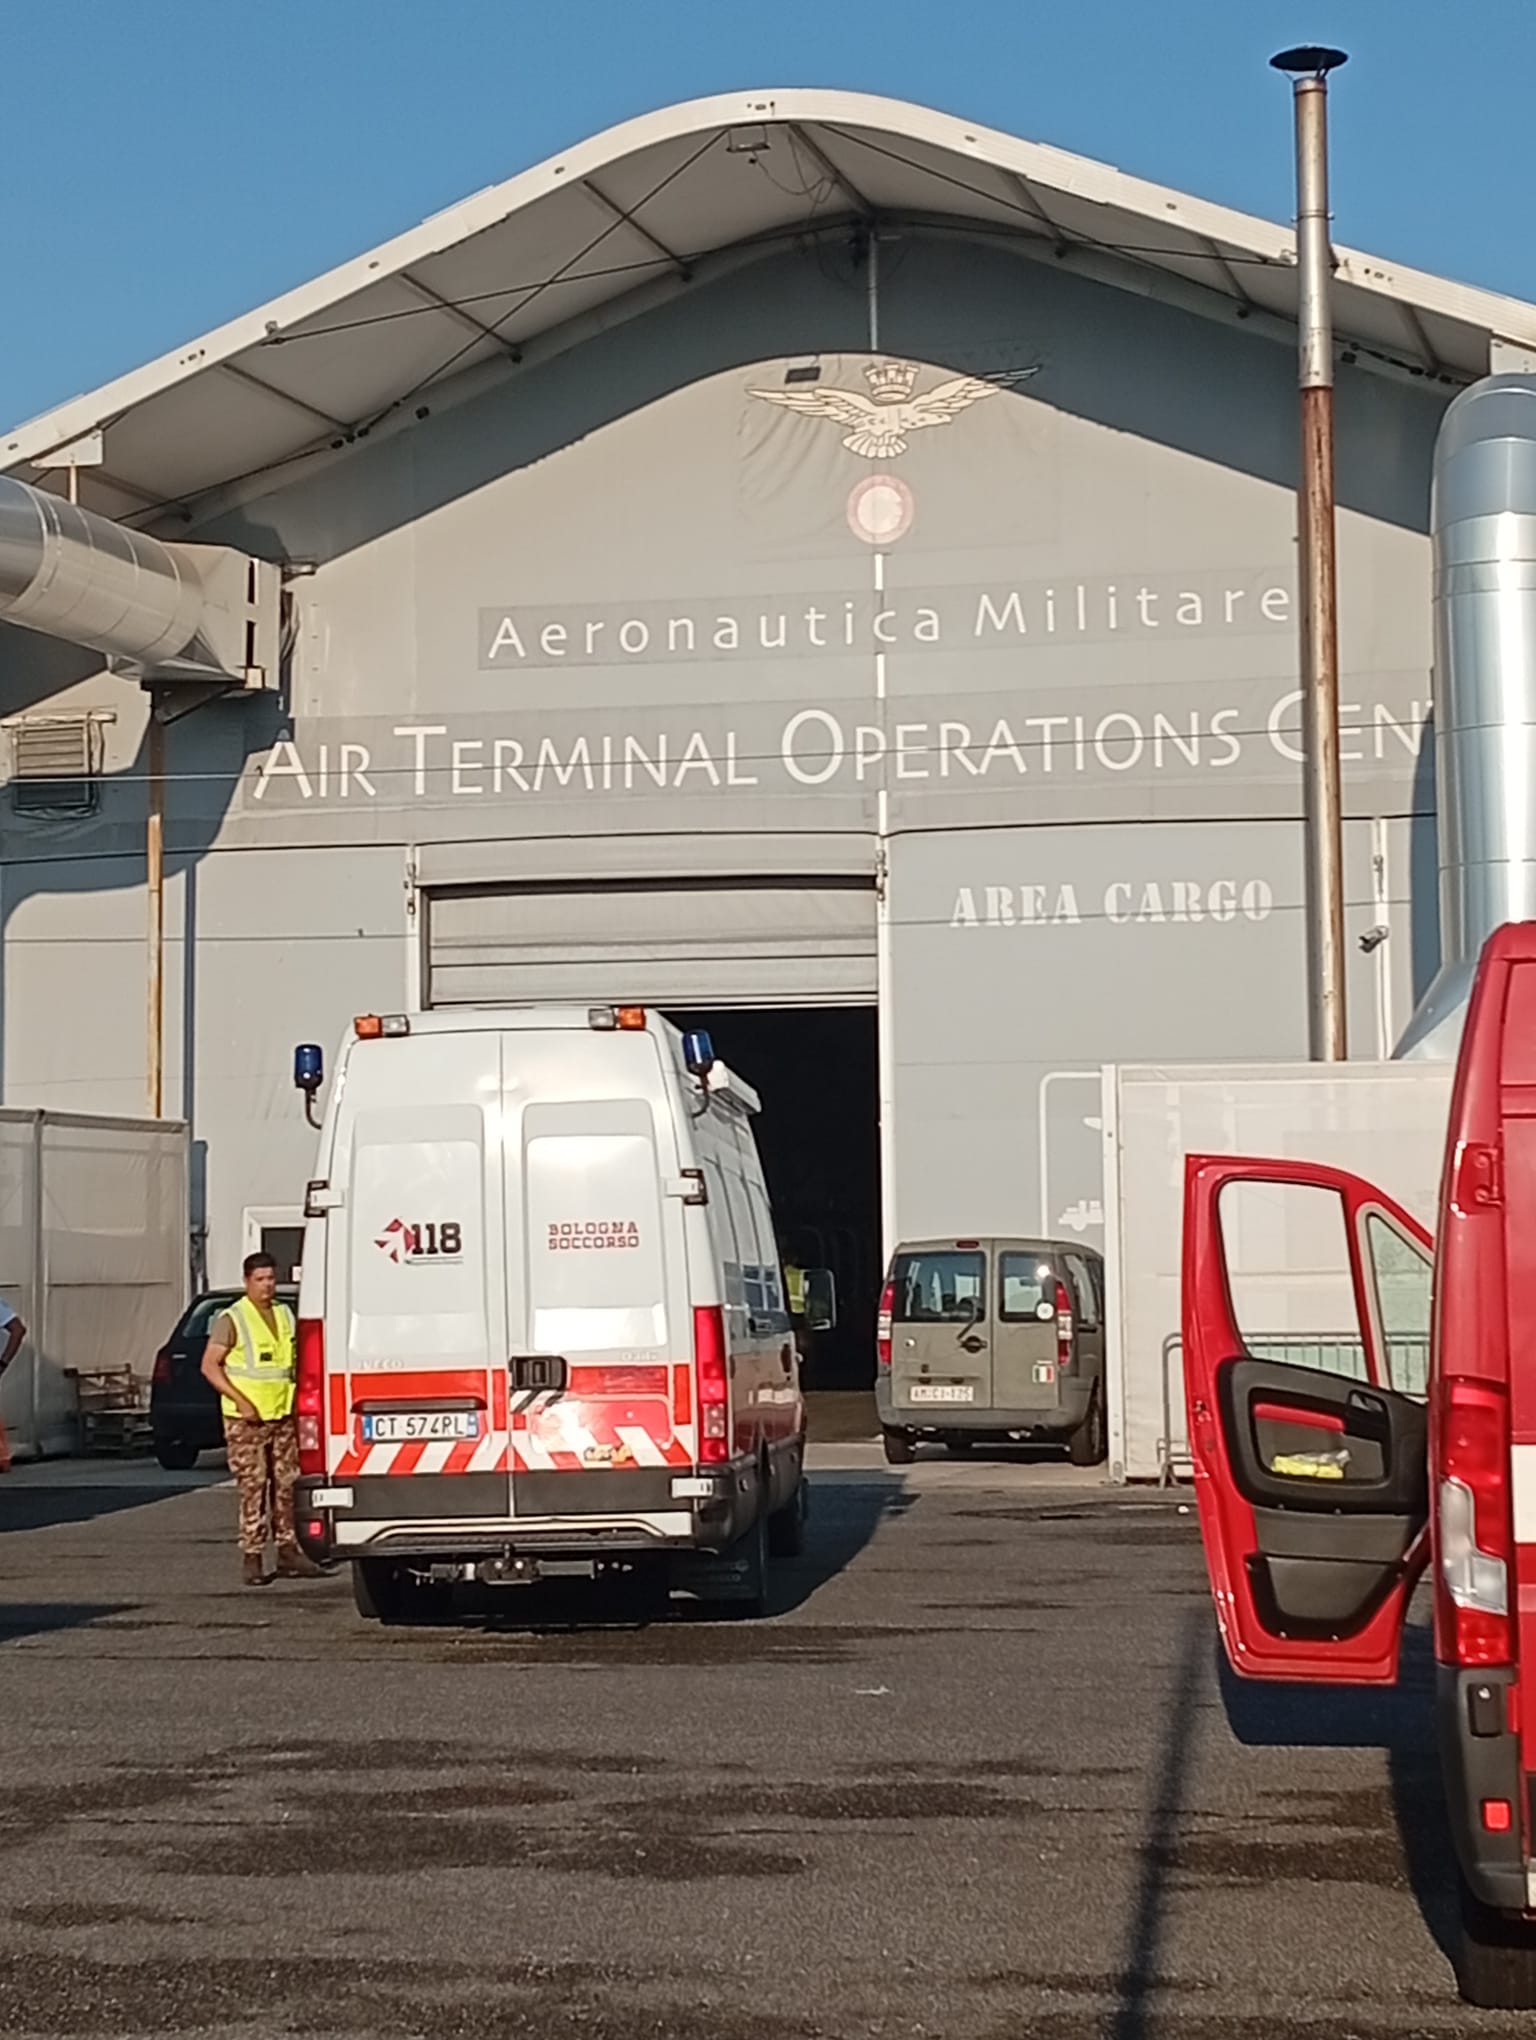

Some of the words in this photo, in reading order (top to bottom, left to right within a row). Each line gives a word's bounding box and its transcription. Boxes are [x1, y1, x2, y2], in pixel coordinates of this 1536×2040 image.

[487, 601, 940, 659] Aeronautica
[974, 585, 1290, 636] Militare
[252, 730, 377, 799] AIR
[393, 725, 759, 796] TERMINAL
[781, 709, 1241, 785] OPERATIONS
[1266, 690, 1434, 762] CEN
[950, 884, 1082, 928] AREA
[1104, 879, 1274, 924] CARGO
[412, 1222, 462, 1255] 118
[548, 1221, 640, 1236] BOLOGNA
[548, 1236, 640, 1250] SOCCORSO
[375, 1417, 398, 1437] CT
